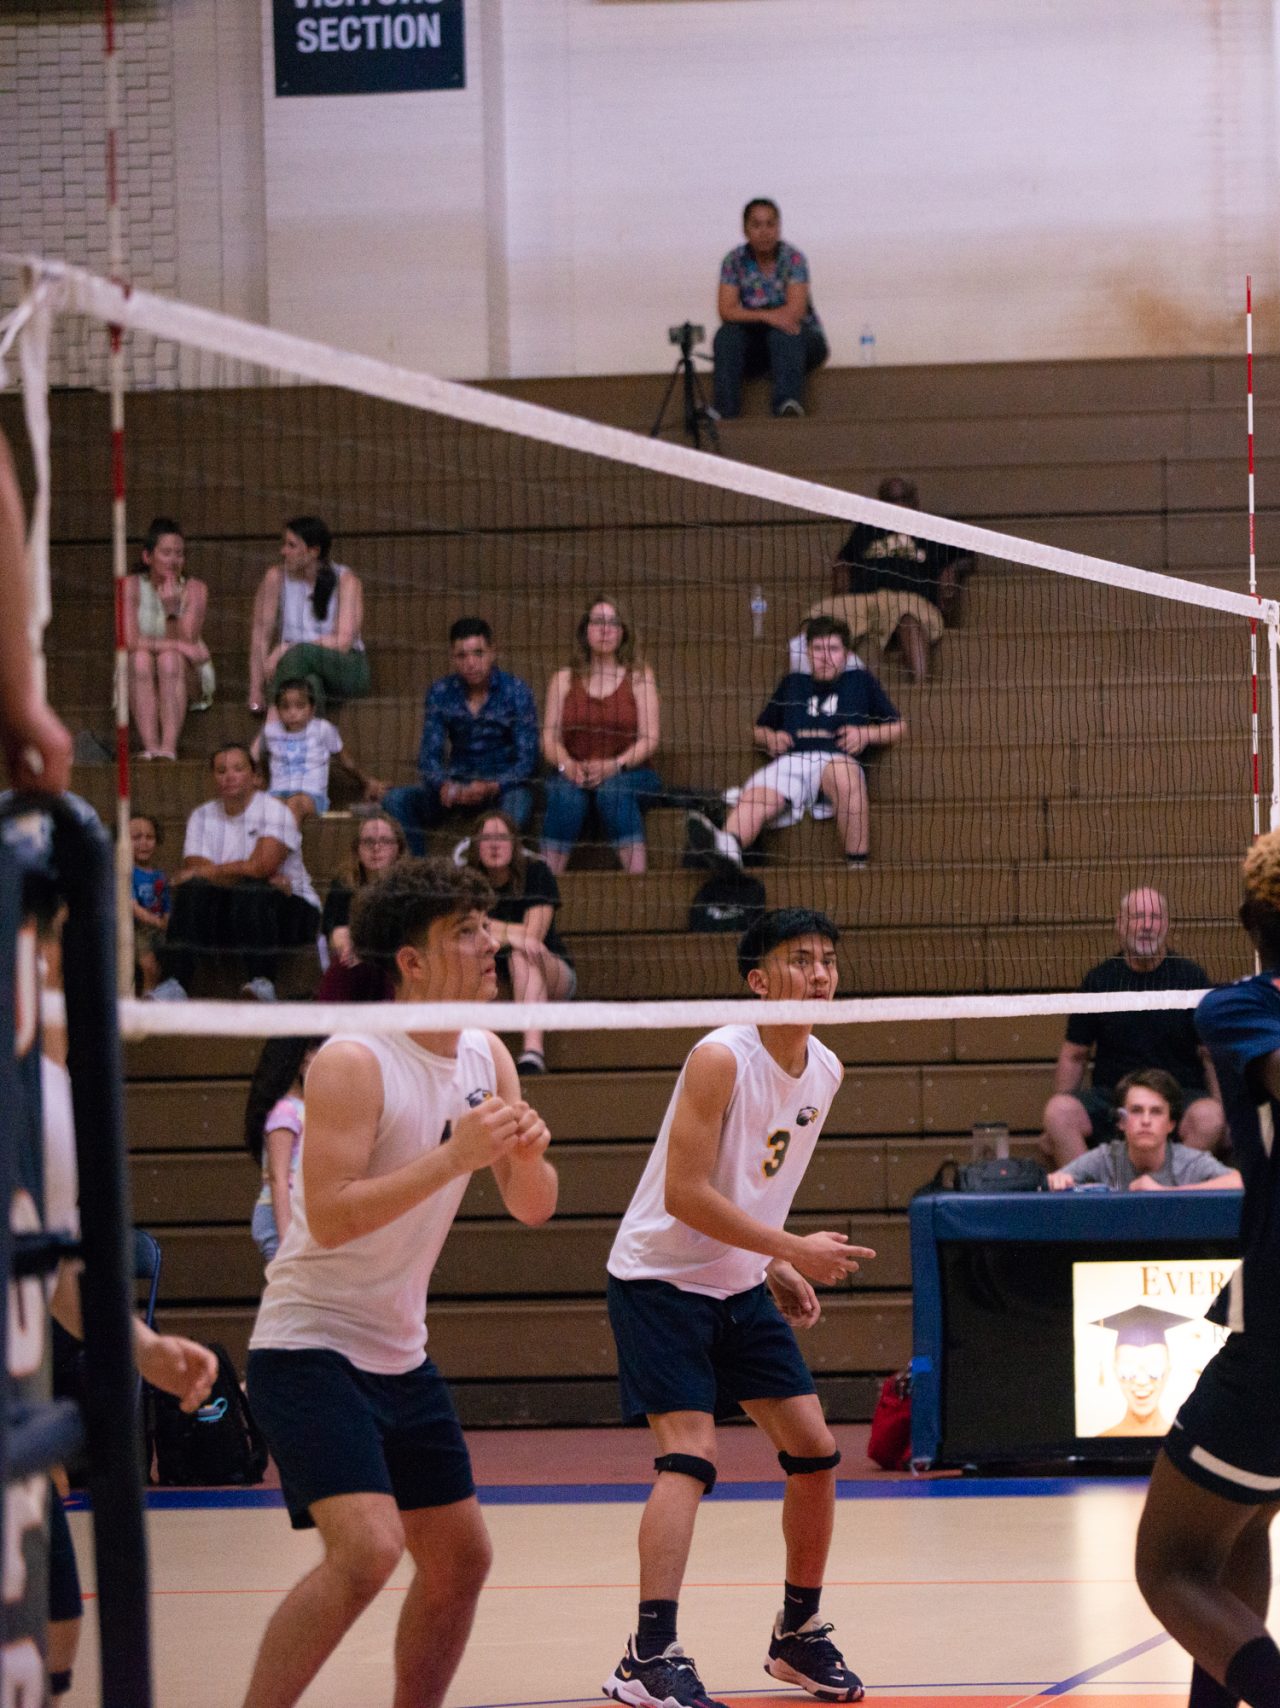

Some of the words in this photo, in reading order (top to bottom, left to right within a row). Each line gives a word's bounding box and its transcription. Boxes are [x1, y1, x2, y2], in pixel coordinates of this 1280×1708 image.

[295, 12, 443, 53] SECTION
[762, 1128, 791, 1178] 3
[1140, 1265, 1226, 1296] EVER
